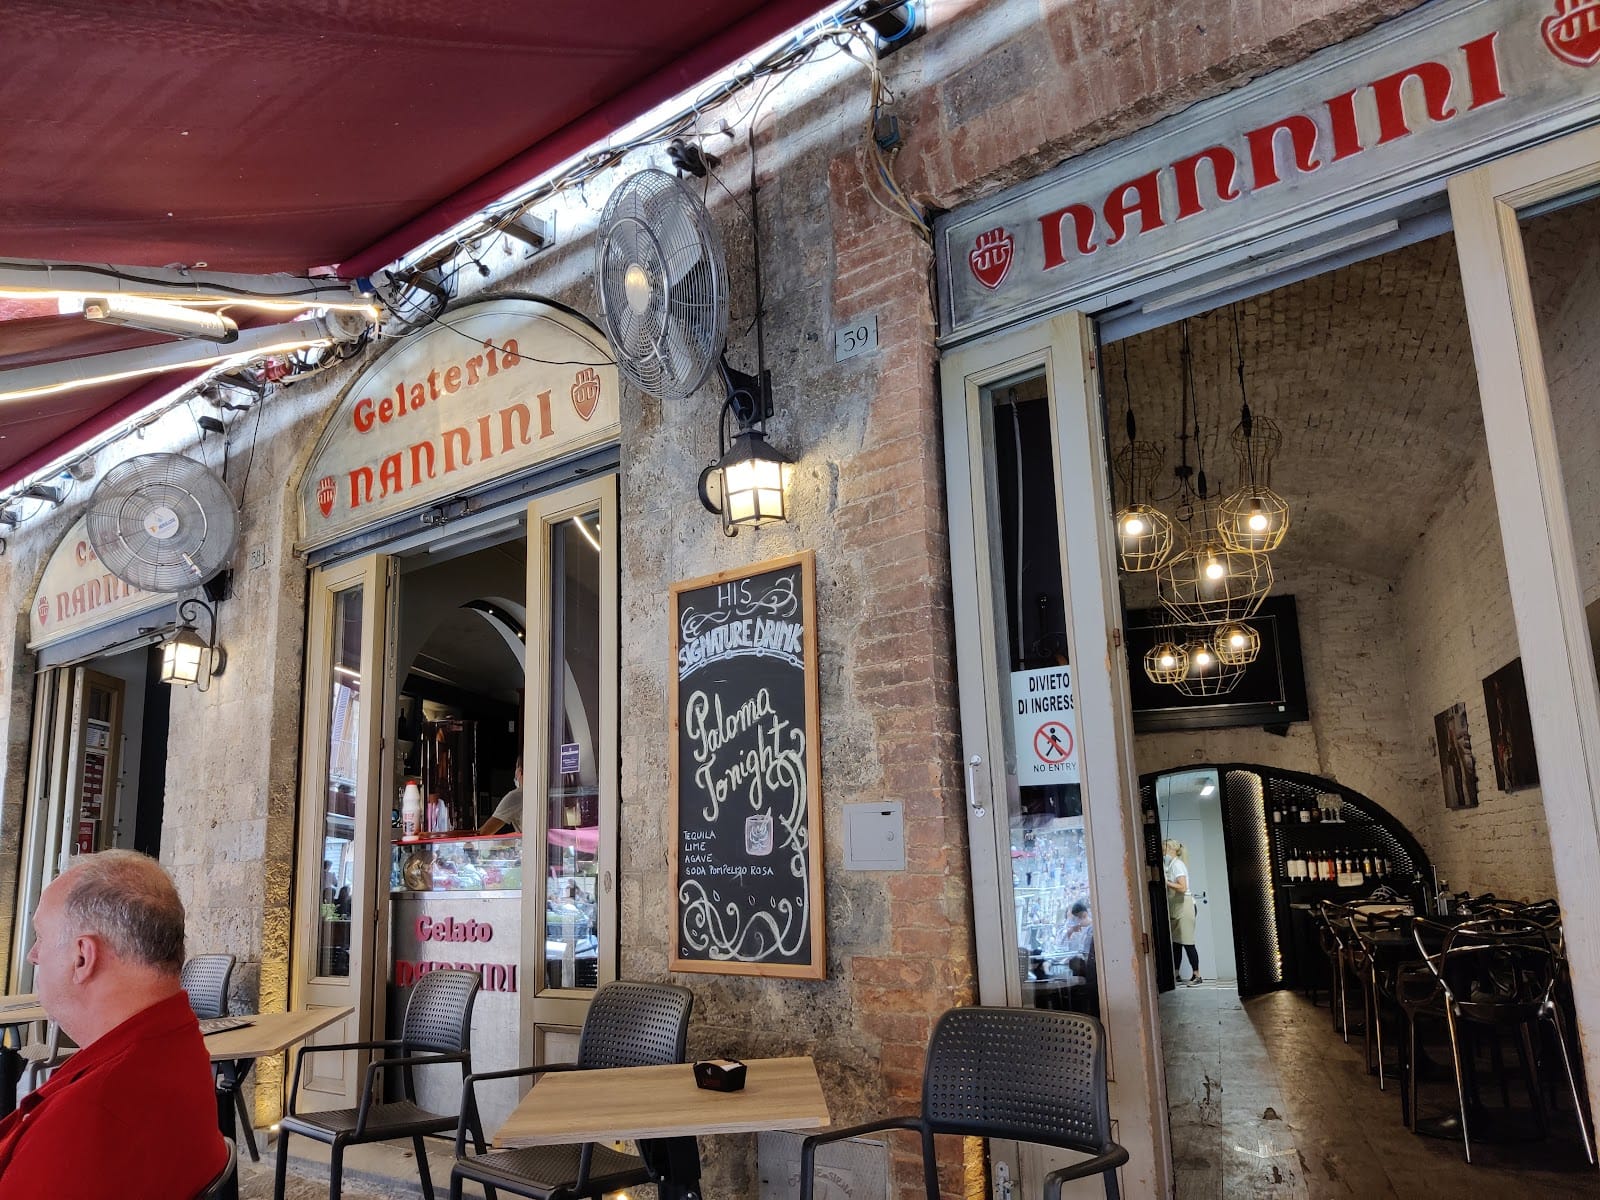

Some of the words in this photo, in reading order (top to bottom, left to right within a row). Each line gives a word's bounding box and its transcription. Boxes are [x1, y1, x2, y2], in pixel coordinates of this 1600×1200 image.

[1039, 31, 1506, 272] NANNINI
[843, 326, 869, 352] 59
[353, 337, 521, 433] Gelateria
[349, 389, 555, 509] NANNINI
[717, 578, 752, 609] HIS
[678, 618, 753, 674] SIGNATURE
[753, 615, 805, 654] DRINK
[1029, 672, 1070, 693] DIVIETO
[1018, 699, 1028, 715] DI
[685, 687, 777, 762] Paloma
[694, 713, 790, 822] Tonight
[1033, 764, 1046, 773] NO
[1048, 762, 1077, 772] ENTRY
[683, 830, 716, 840] TEQUILA
[685, 842, 706, 851] LIME
[684, 853, 713, 864] AGAVE
[685, 866, 706, 876] SODA
[750, 865, 774, 876] ROSA
[414, 915, 493, 943] Gelato
